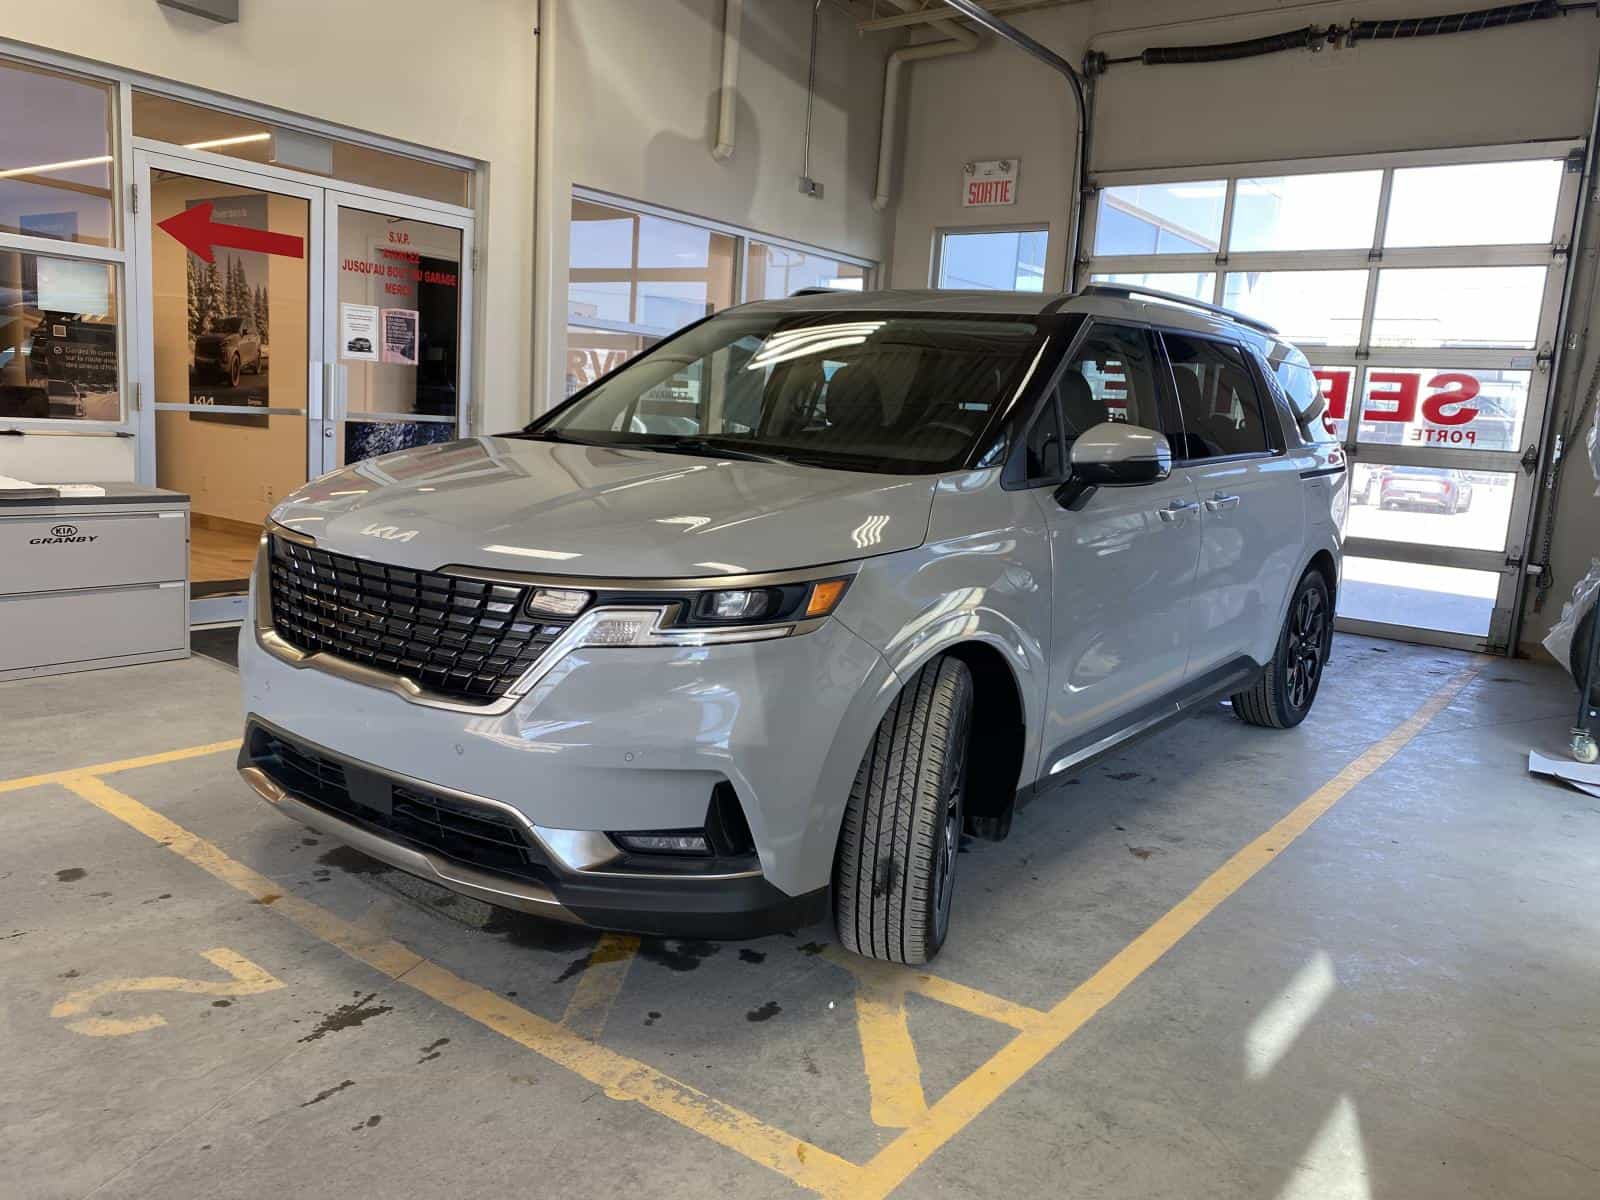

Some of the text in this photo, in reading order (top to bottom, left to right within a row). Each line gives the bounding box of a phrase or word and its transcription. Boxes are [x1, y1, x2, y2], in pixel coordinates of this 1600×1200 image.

[968, 180, 1011, 204] SORTIE
[388, 231, 410, 245] S.V.P.
[342, 259, 385, 276] JUSQU'AU
[424, 271, 457, 286] GARAGE
[384, 283, 414, 296] MERCI
[55, 526, 74, 536] KIA
[29, 535, 99, 545] GRANBY
